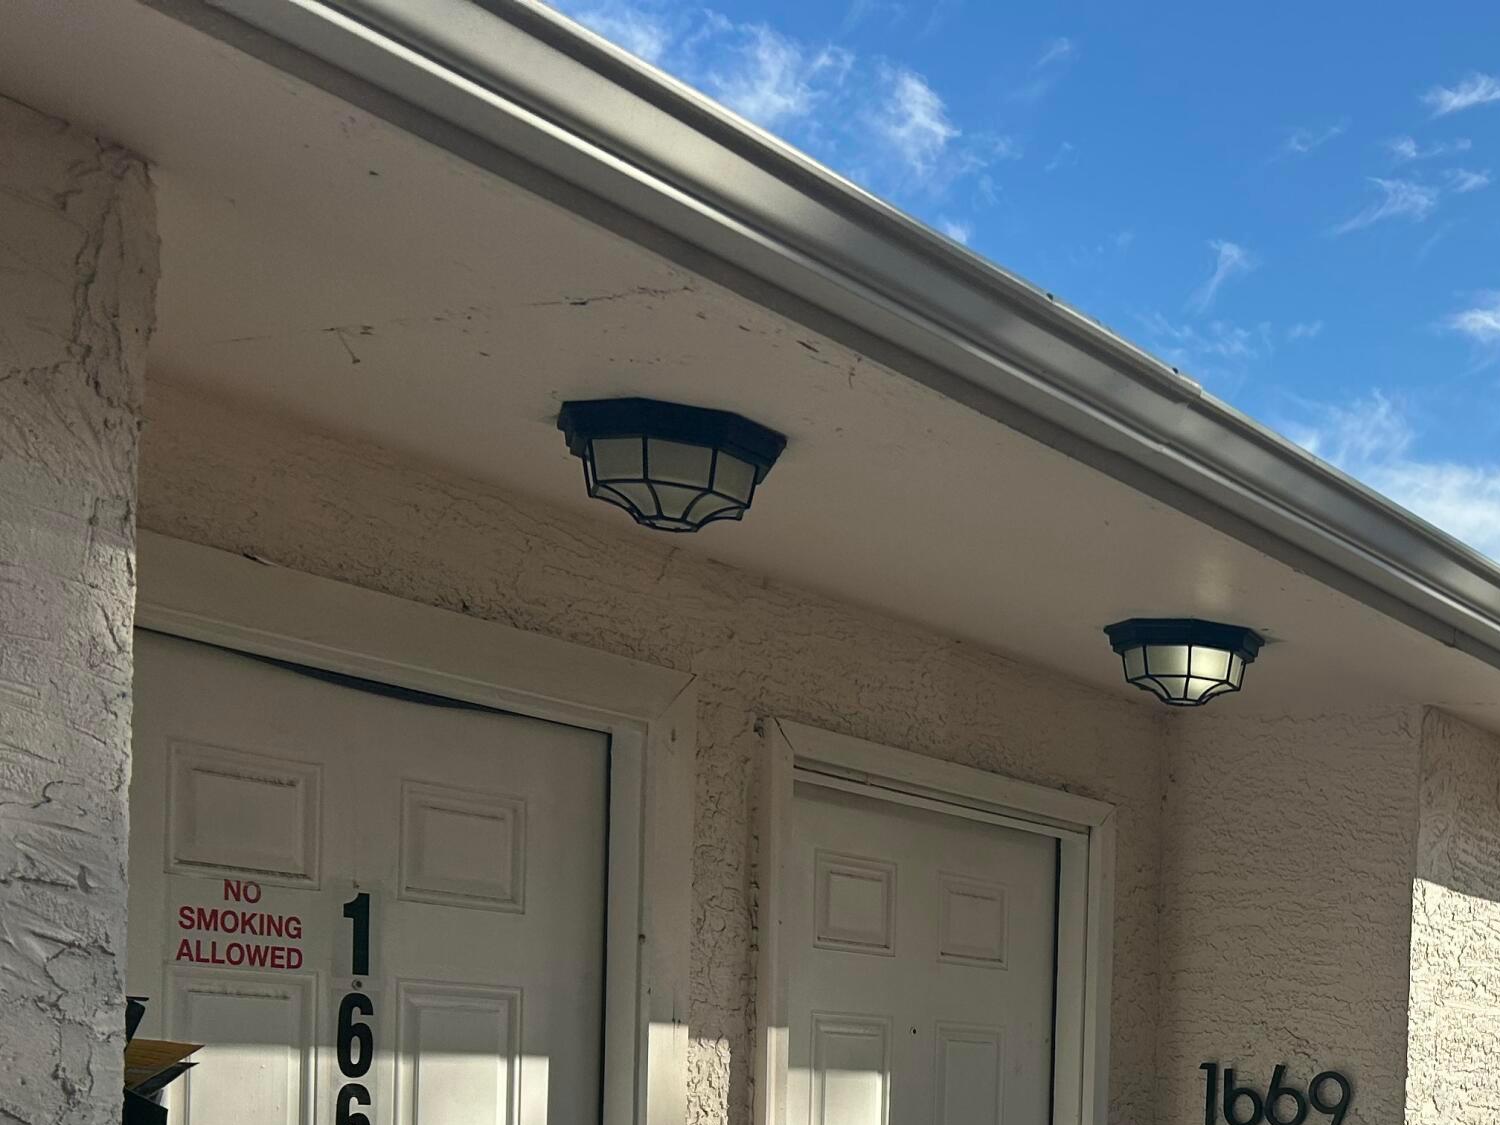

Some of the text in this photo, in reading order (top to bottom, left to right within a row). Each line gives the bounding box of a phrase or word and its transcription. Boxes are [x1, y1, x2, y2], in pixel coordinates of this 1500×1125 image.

[223, 879, 261, 904] NO
[178, 906, 302, 939] SMOKING
[175, 939, 303, 969] ALLOWED
